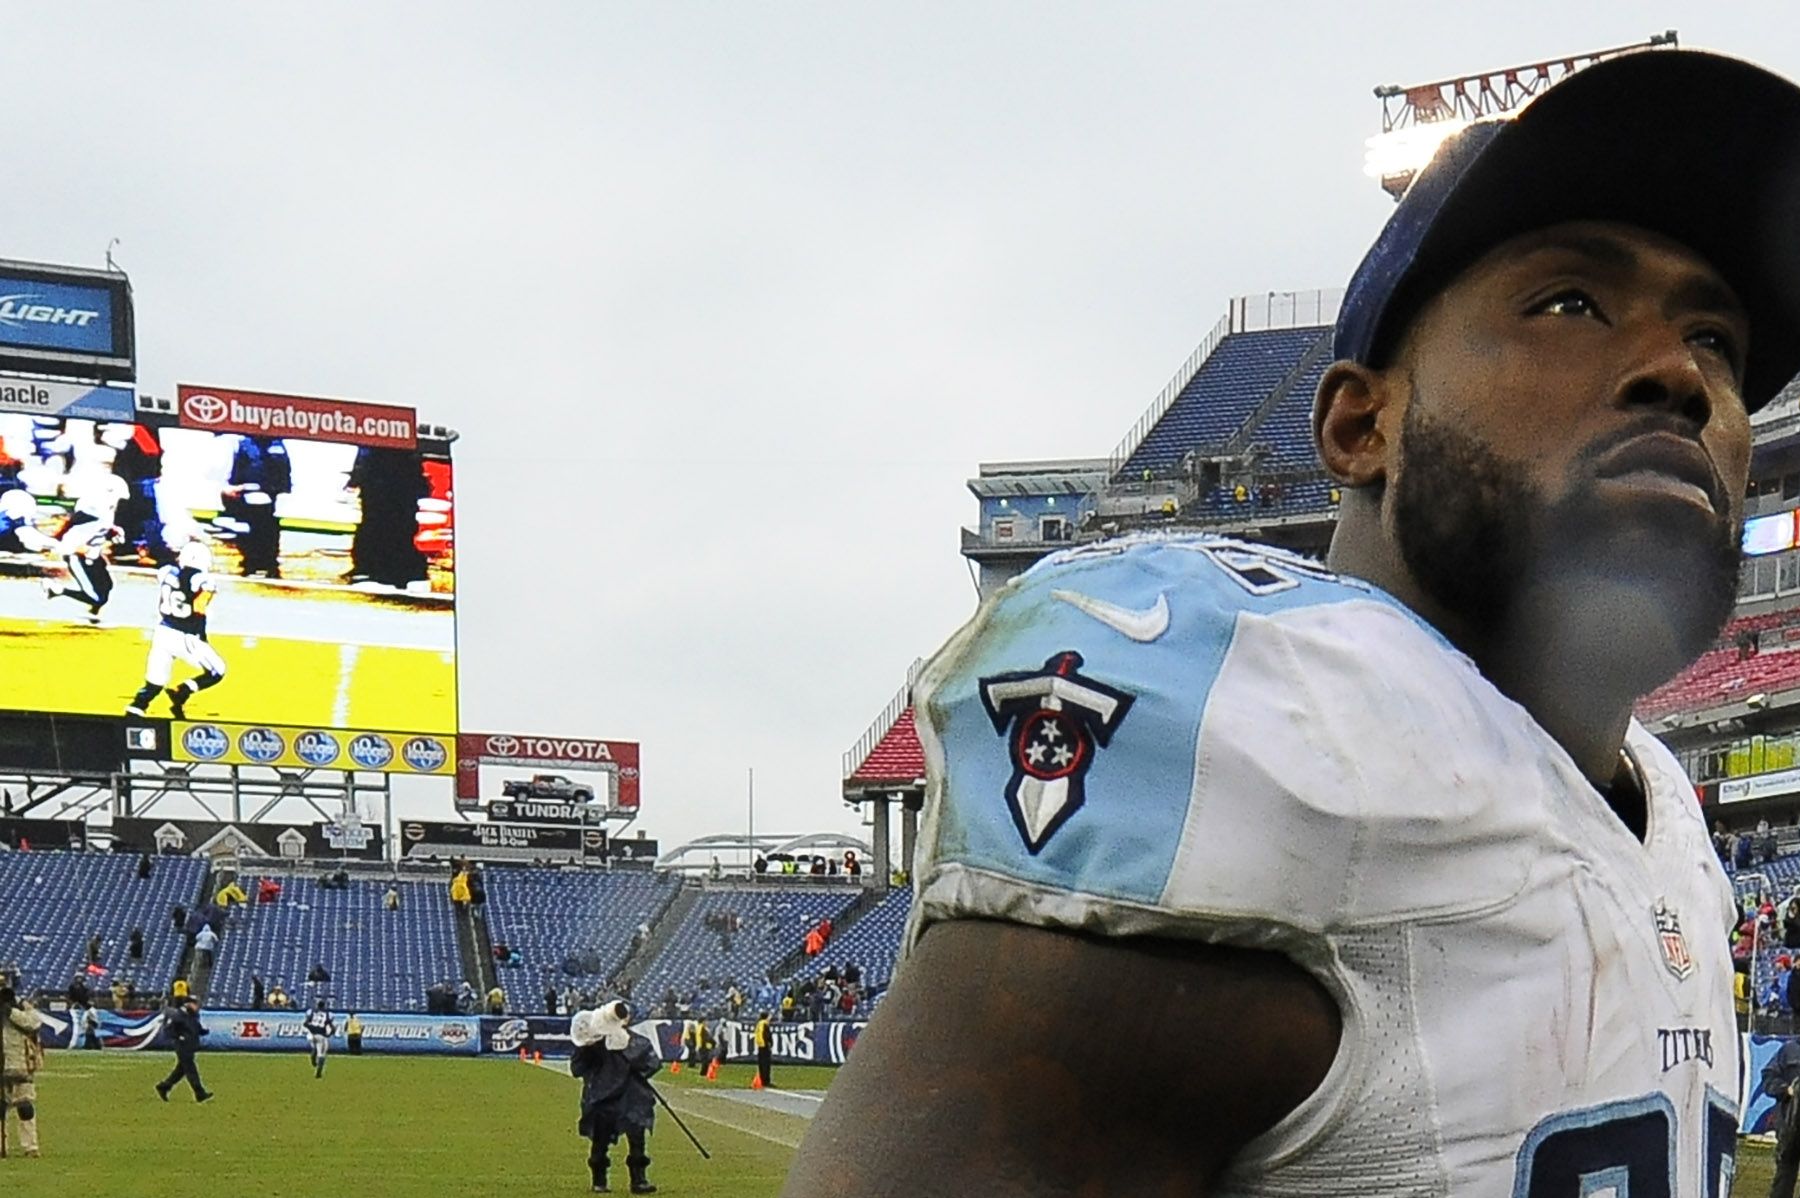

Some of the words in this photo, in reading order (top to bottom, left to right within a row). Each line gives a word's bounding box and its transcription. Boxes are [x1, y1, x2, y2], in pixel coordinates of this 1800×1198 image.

[0, 301, 99, 326] LIGHT
[230, 400, 410, 439] buyatoyota.com
[522, 738, 612, 760] TOYOTA
[514, 802, 585, 819] TUNDRA
[727, 1022, 814, 1060] TITNS
